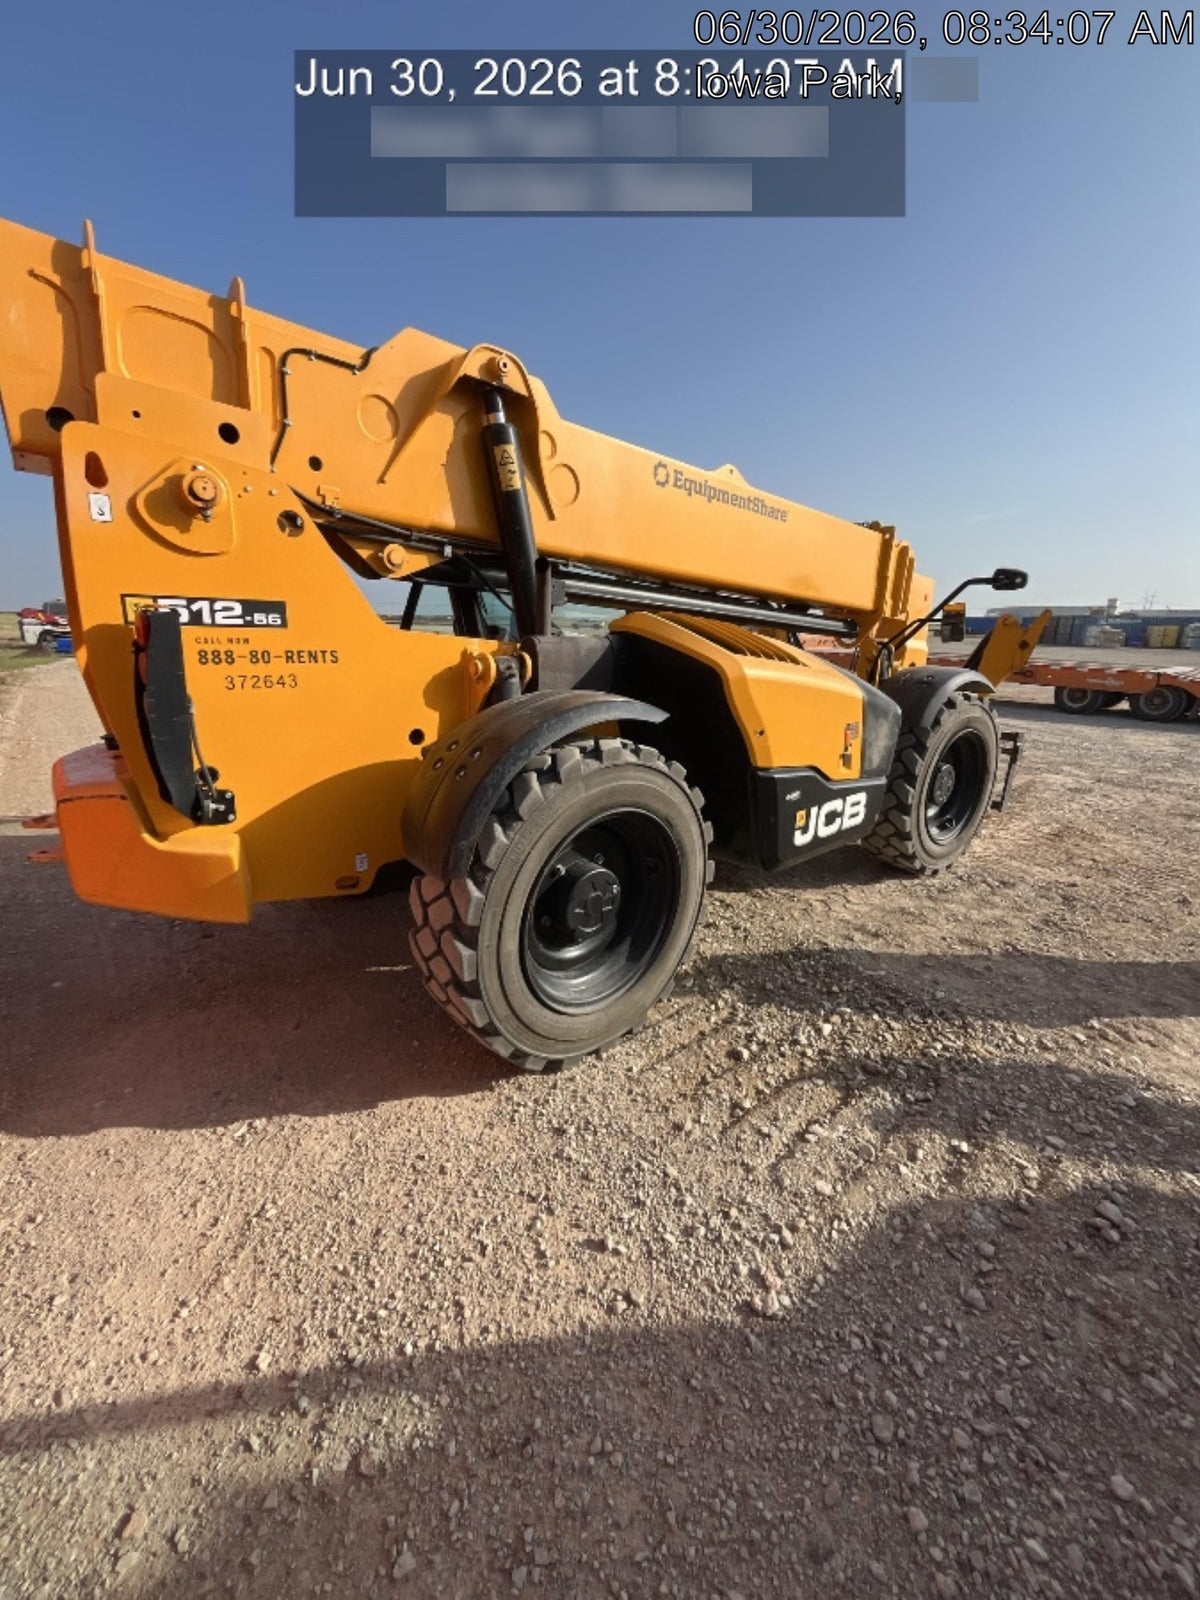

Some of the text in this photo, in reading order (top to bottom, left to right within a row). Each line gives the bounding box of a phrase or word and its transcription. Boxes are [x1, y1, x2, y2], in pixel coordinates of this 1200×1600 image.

[673, 469, 788, 522] EquipmentShare
[198, 650, 339, 665] 888-80-RENTS
[225, 673, 298, 690] 372643
[793, 791, 867, 847] JCB
